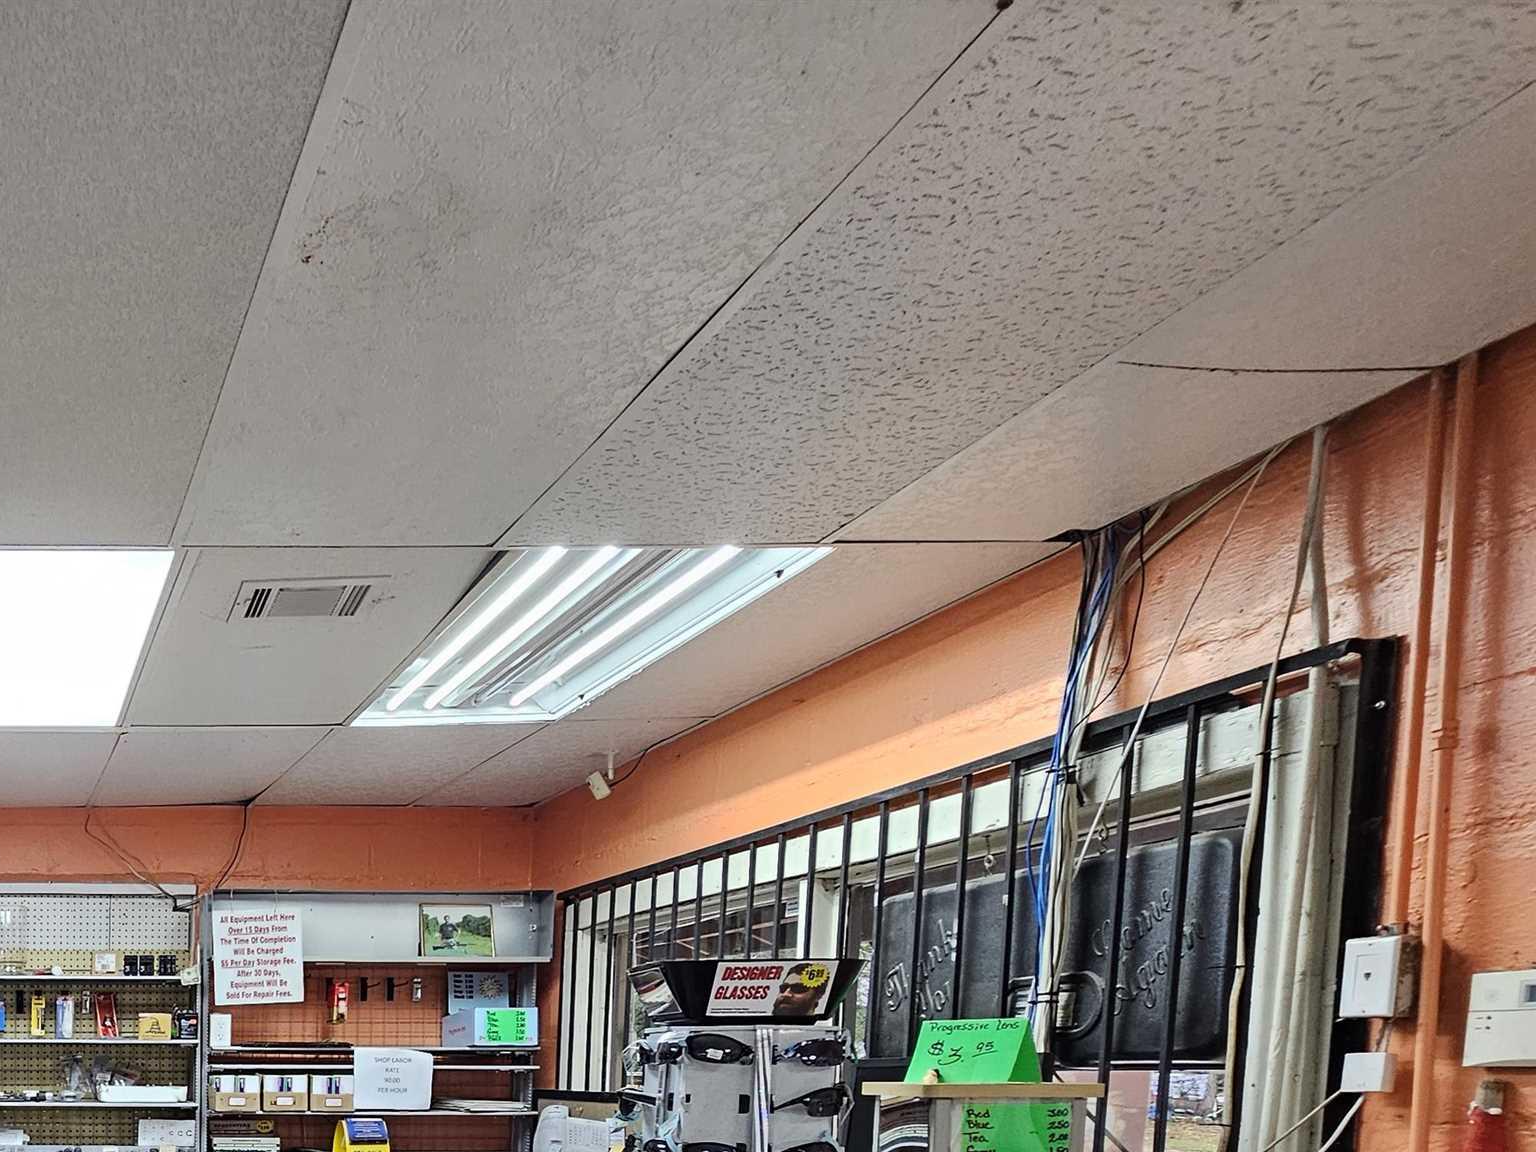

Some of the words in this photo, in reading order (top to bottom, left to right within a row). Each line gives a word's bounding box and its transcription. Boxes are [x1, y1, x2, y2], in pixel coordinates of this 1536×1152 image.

[230, 914, 264, 924] Equipment
[266, 914, 278, 922] Left
[280, 913, 295, 921] Here
[228, 926, 243, 934] Over
[254, 926, 270, 934] Days
[260, 936, 296, 944] Completion
[256, 947, 284, 956] Charged
[230, 959, 242, 967] Per
[243, 958, 254, 967] Day
[256, 958, 282, 967] Storage
[721, 966, 784, 981] DESIGNER
[230, 980, 264, 989] Equipment
[226, 992, 240, 1000] Sold
[242, 991, 252, 999] For
[254, 990, 274, 1000] Repair
[714, 985, 770, 1000] GLASSES
[929, 1021, 990, 1035] Progressive
[966, 1109, 990, 1118] Red
[965, 1120, 994, 1129] Blue
[963, 1132, 989, 1142] Tea
